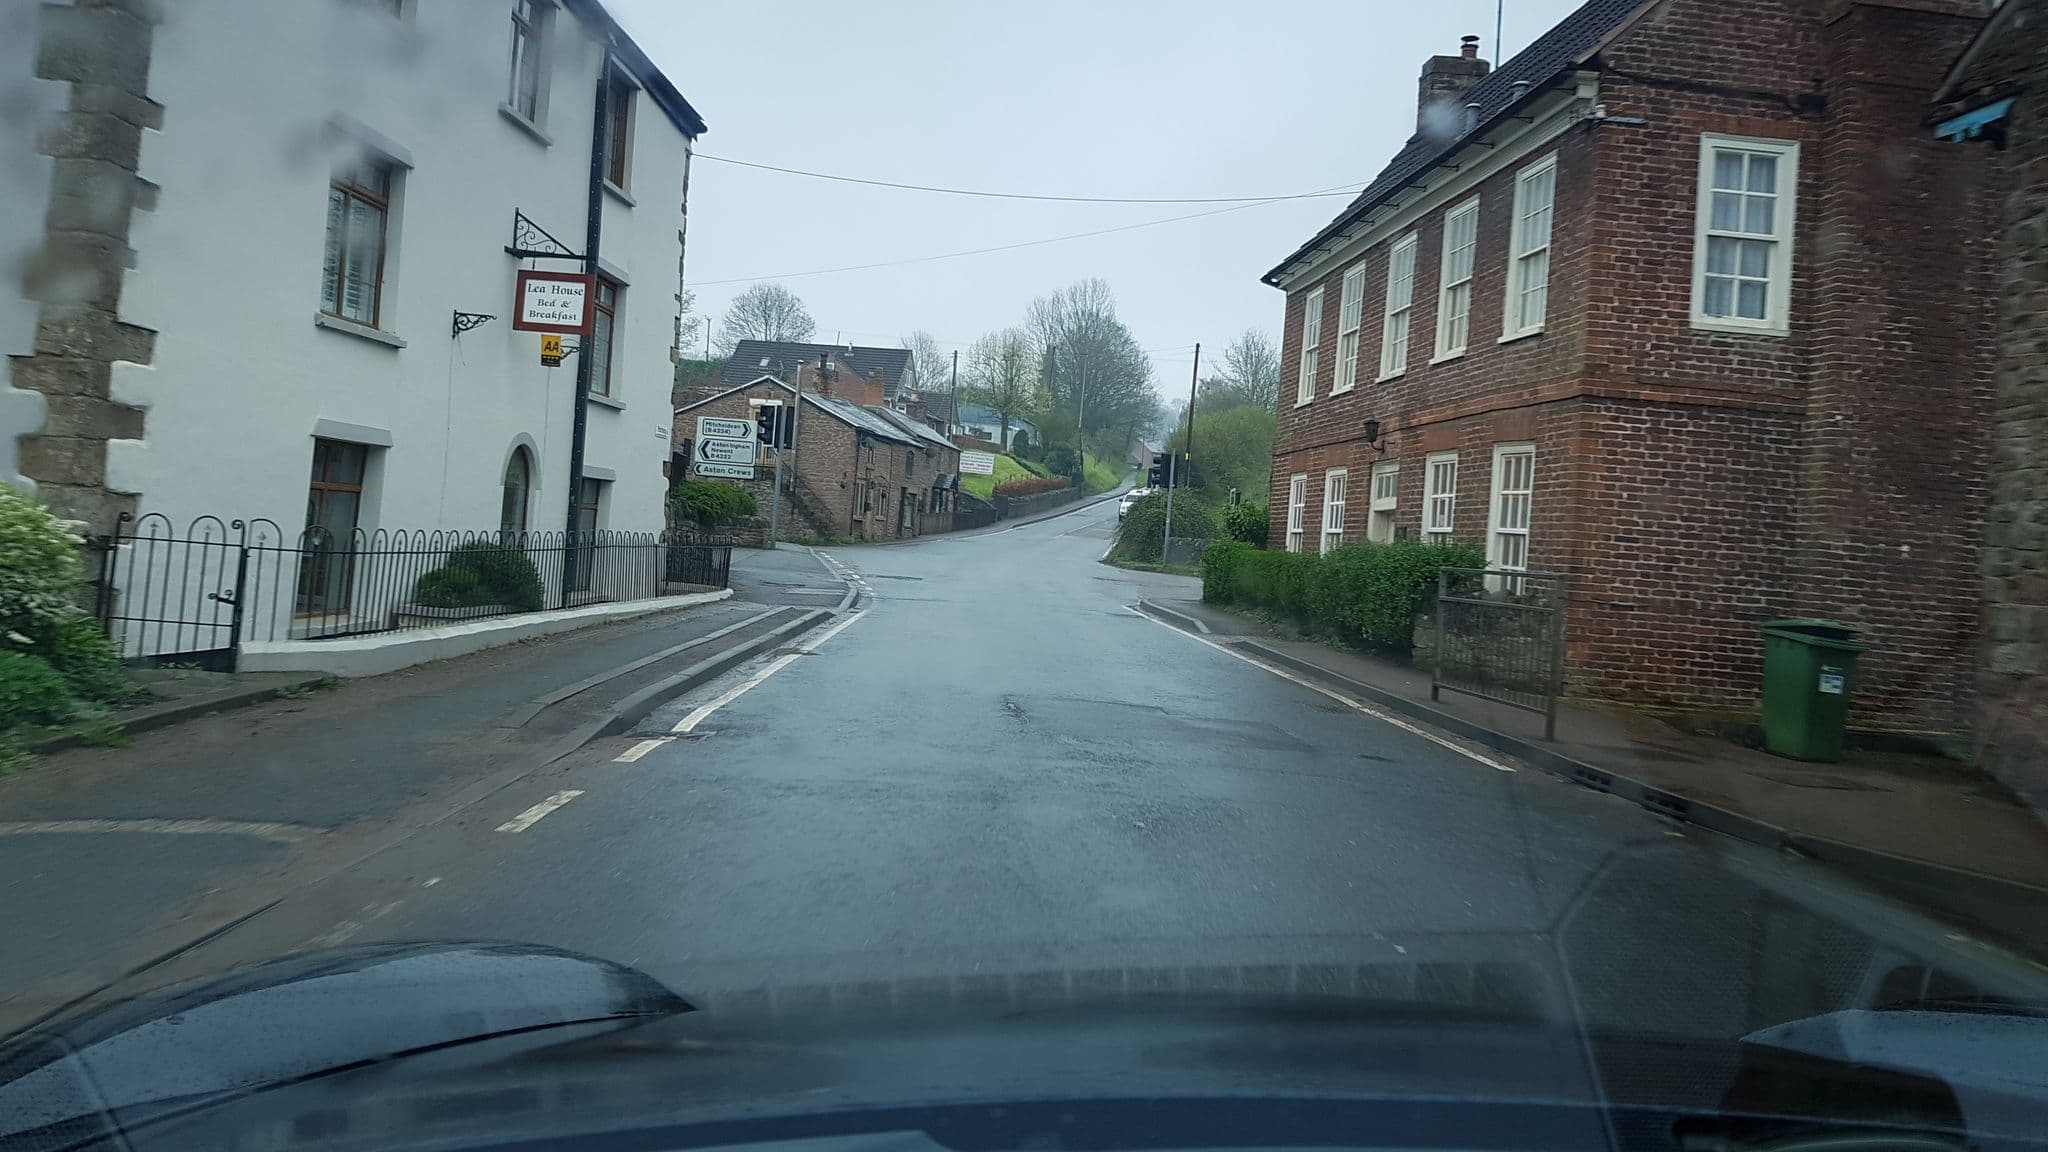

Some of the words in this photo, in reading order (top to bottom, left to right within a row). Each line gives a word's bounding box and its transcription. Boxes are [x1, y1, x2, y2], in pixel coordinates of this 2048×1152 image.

[528, 283, 546, 293] Lea
[551, 285, 584, 296] House
[537, 299, 556, 307] Bed
[529, 310, 577, 321] Breakfast
[544, 340, 559, 352] AA
[705, 421, 741, 429] Mitcheldean
